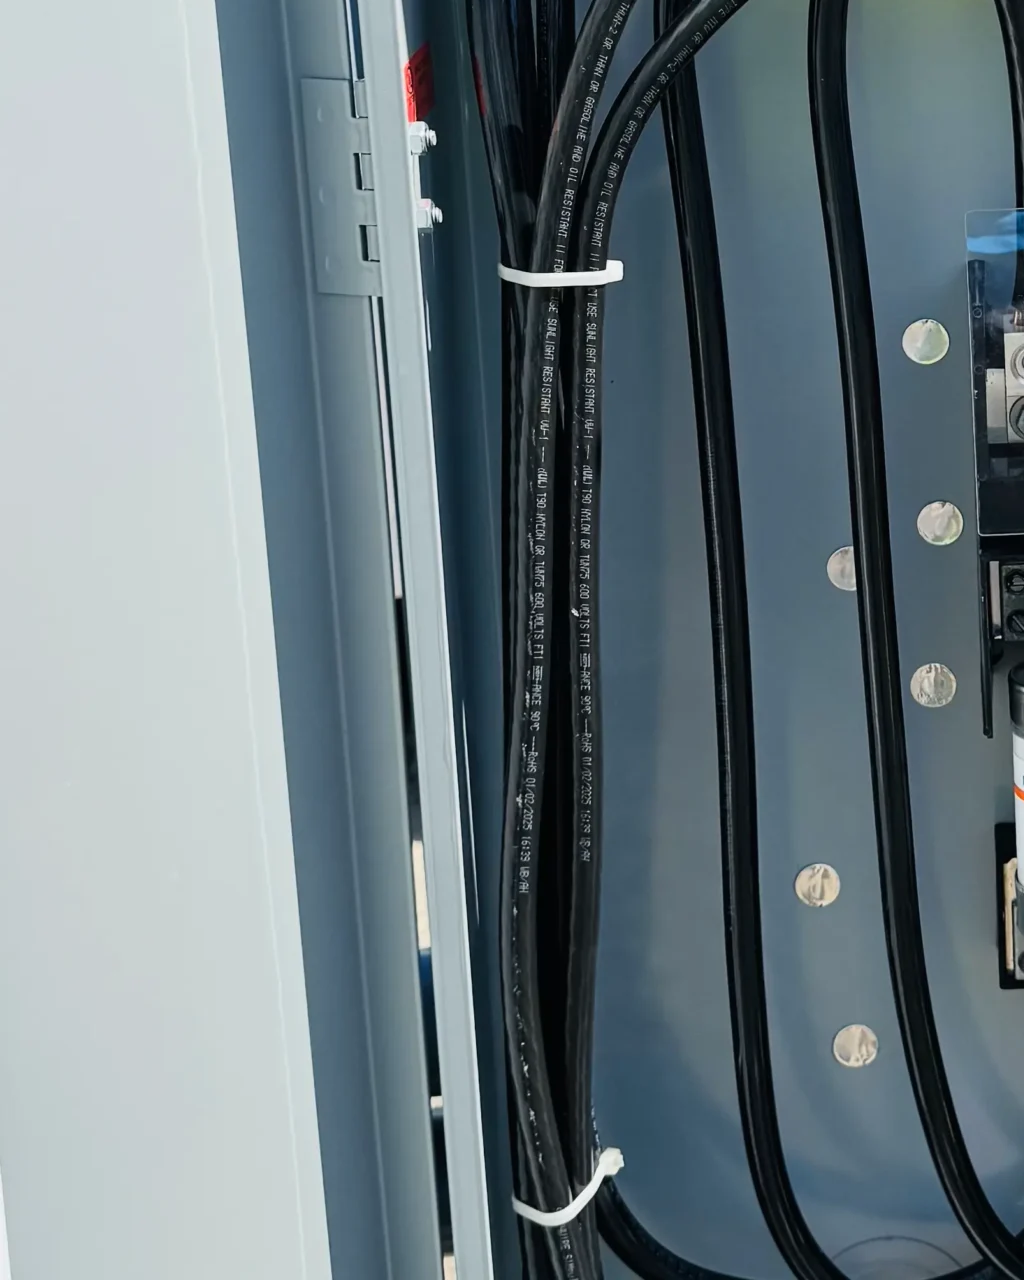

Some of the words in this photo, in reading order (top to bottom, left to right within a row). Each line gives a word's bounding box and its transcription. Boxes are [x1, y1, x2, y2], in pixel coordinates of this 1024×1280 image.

[608, 2, 630, 34] THWN-2
[602, 37, 614, 50] OR
[692, 32, 704, 44] OR
[594, 54, 608, 78] THHN
[589, 80, 600, 93] OR
[656, 72, 669, 84] OR
[576, 96, 595, 142] GASOLINE
[634, 106, 646, 118] OR
[614, 120, 638, 160] GASOLINE
[572, 145, 584, 163] AND
[567, 167, 578, 184] OIL
[607, 162, 620, 179] AND
[600, 181, 614, 196] OIL
[558, 188, 574, 239] RESISTANT
[591, 201, 608, 248] RESISTANT
[586, 302, 598, 318] USE
[544, 318, 558, 361] SUNLIGHT
[586, 322, 597, 363] SUNLIGHT
[540, 366, 554, 415] RESISTANT
[584, 368, 596, 414] RESISTANT
[539, 419, 550, 440] VW-1
[584, 419, 594, 439] VW-1
[536, 492, 546, 509] T90
[582, 488, 592, 504] T90
[535, 513, 546, 541] NYLON
[580, 508, 591, 535] NYLON
[534, 544, 546, 556] OR
[580, 538, 590, 550] OR
[534, 592, 544, 608] 600
[580, 583, 590, 600] 600
[579, 604, 590, 629] VOLTS
[534, 614, 544, 640] VOLTS
[580, 633, 590, 648] FT1
[534, 644, 544, 659] FT1
[581, 756, 592, 806] 01/02/2025
[522, 777, 536, 831] 01/02/2025
